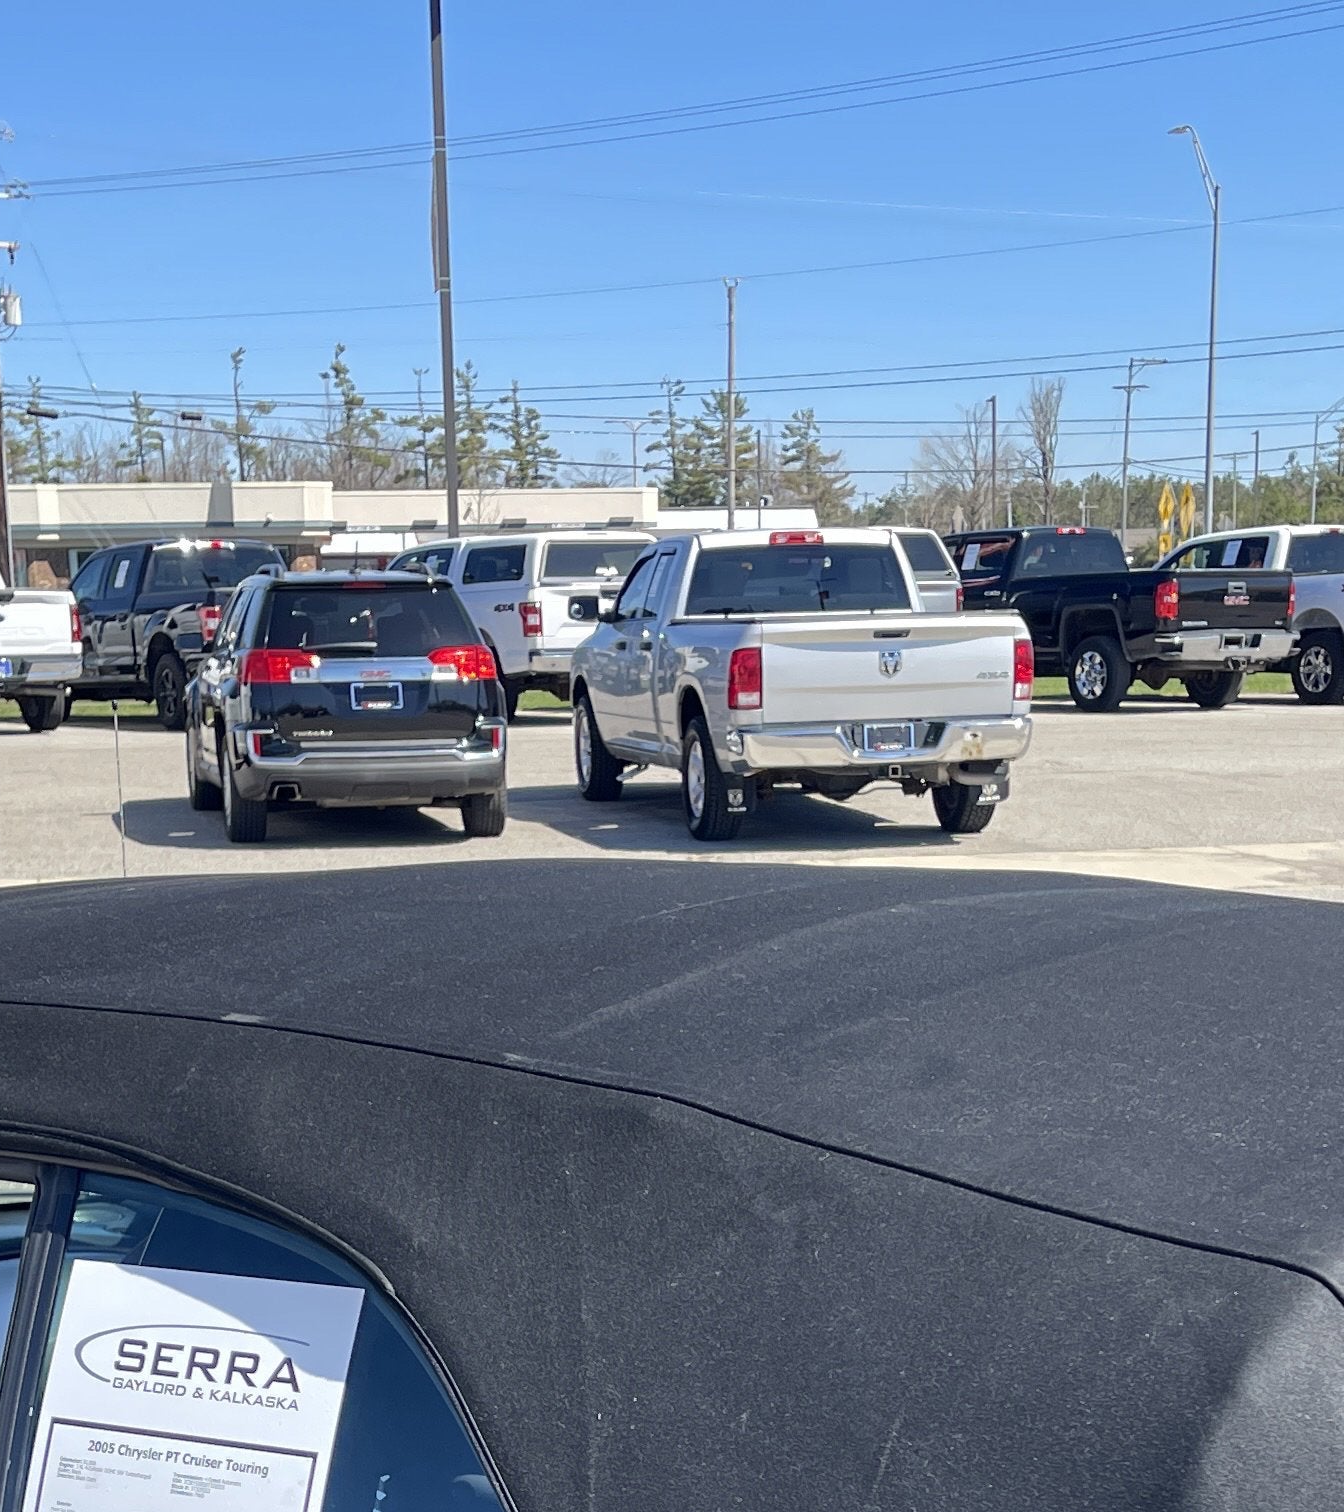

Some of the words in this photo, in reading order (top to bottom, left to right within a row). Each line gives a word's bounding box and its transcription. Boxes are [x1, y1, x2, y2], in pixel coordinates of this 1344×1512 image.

[113, 1337, 302, 1393] SERRA
[112, 1376, 187, 1397] GAYLORD
[192, 1386, 204, 1400] &
[208, 1389, 300, 1412] KALKASKA
[87, 1439, 116, 1454] 2005
[117, 1443, 164, 1461] Chrysler
[165, 1450, 181, 1463] PT
[182, 1453, 223, 1470] Cruiser
[225, 1458, 270, 1479] Touring
